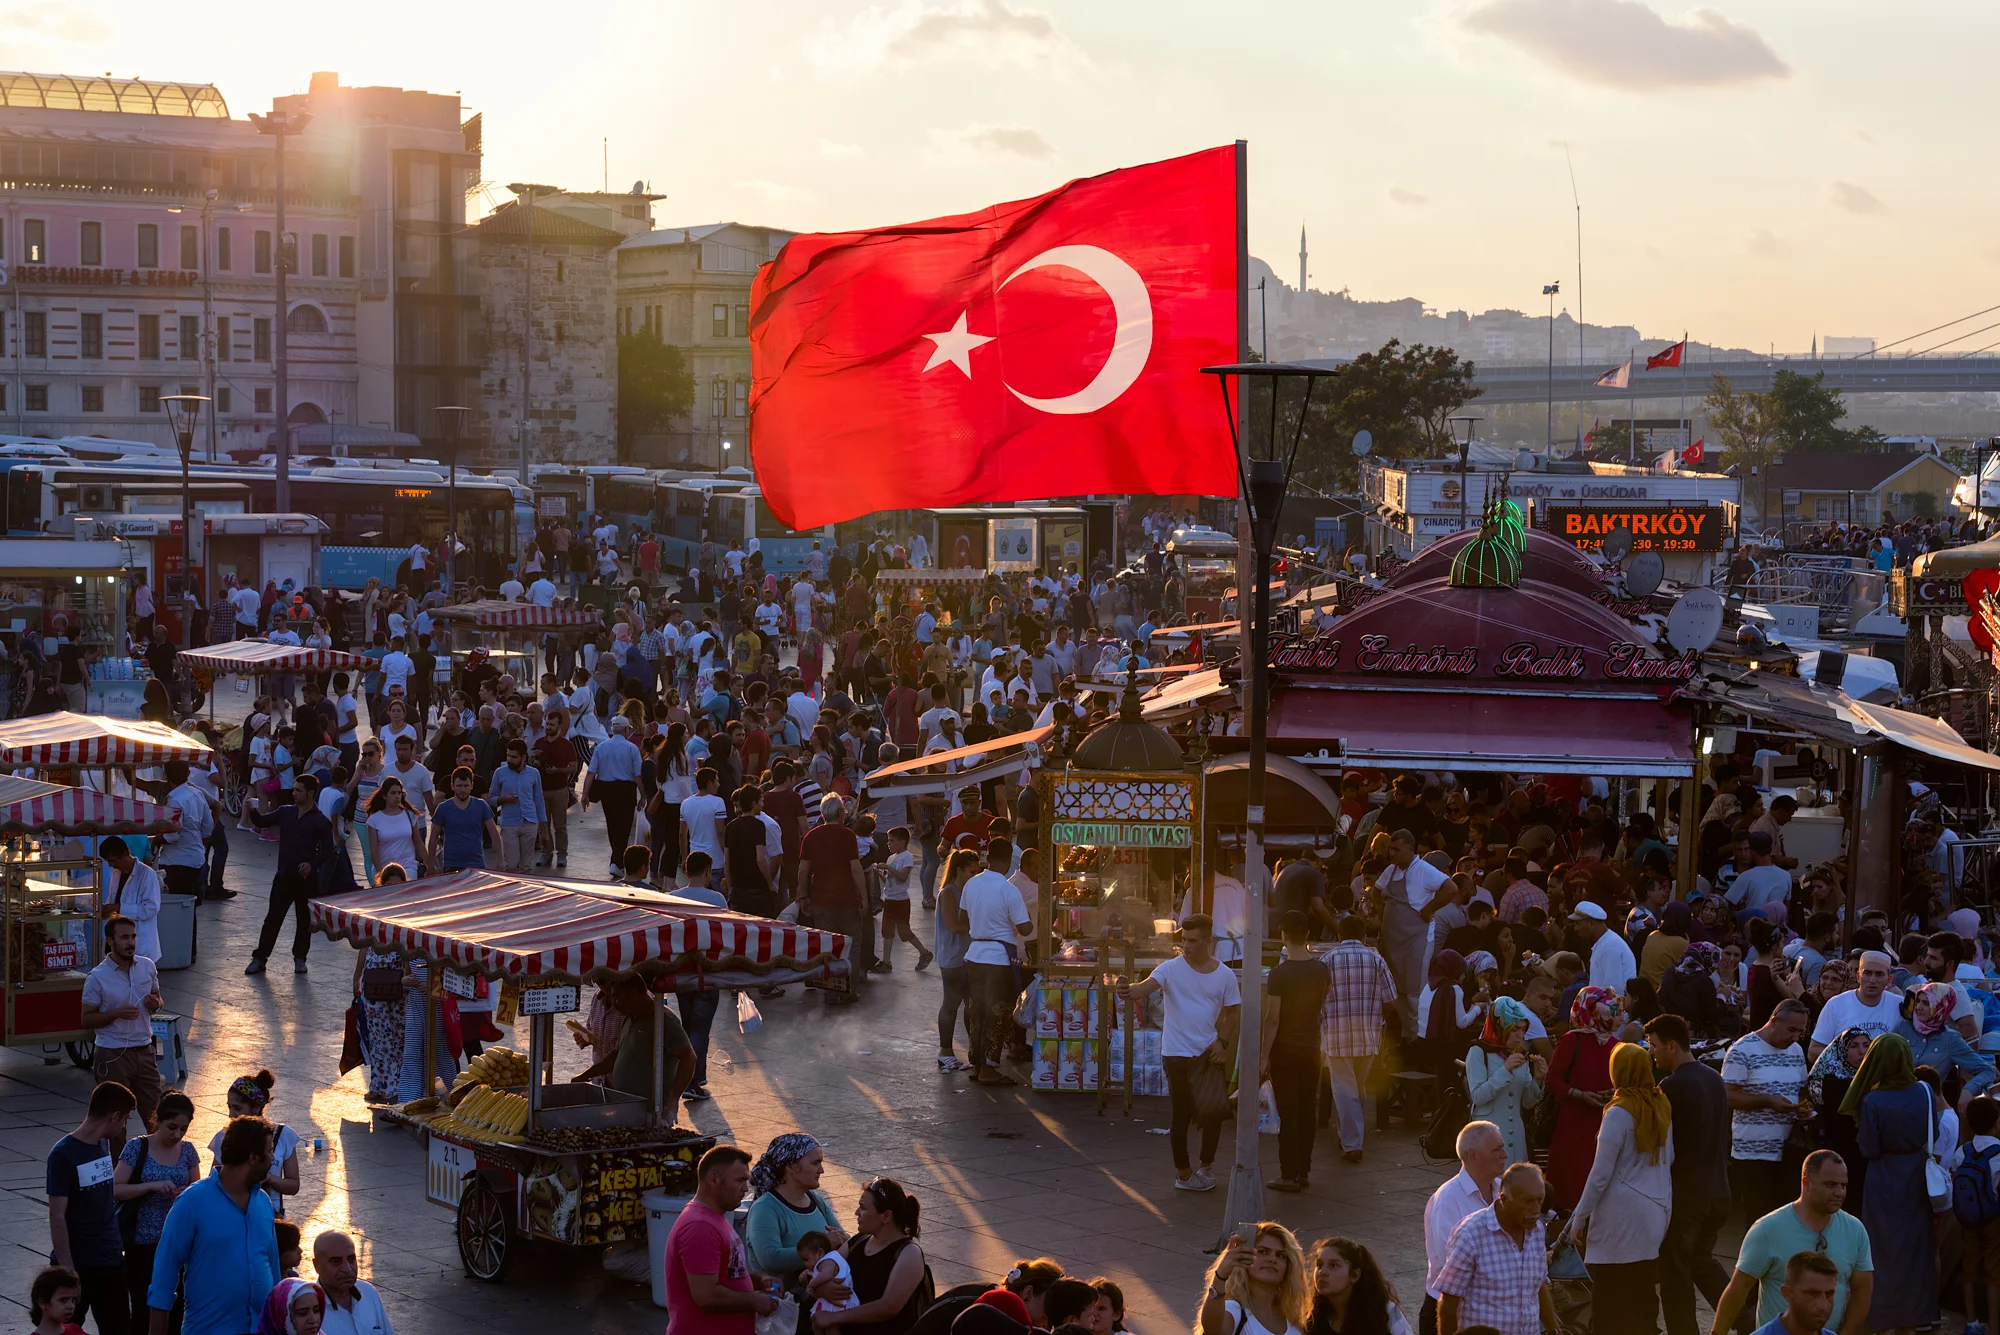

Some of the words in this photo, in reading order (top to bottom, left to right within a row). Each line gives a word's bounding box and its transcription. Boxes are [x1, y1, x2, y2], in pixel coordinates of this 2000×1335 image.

[16, 266, 124, 284] RESTAURANT
[130, 270, 140, 285] &
[147, 270, 199, 286] KEBAP
[1498, 484, 1554, 498] ADIKÖY
[1561, 489, 1576, 498] ve
[1582, 485, 1647, 499] ÜSKÜDAR
[128, 524, 154, 532] Garanti
[1576, 539, 1605, 550] 17:4
[1663, 540, 1696, 550] 19:30
[1268, 632, 1341, 668] Tarihi
[1357, 634, 1478, 673] Eminönü
[1494, 642, 1585, 678] Balık
[1604, 642, 1698, 679] Ekmek
[1125, 825, 1191, 848] LOKMASI
[45, 946, 57, 955] TAŞ
[58, 944, 76, 954] FIRIN
[497, 1001, 508, 1022] 2
[506, 1011, 516, 1024] TL
[599, 1165, 665, 1192] KESTA
